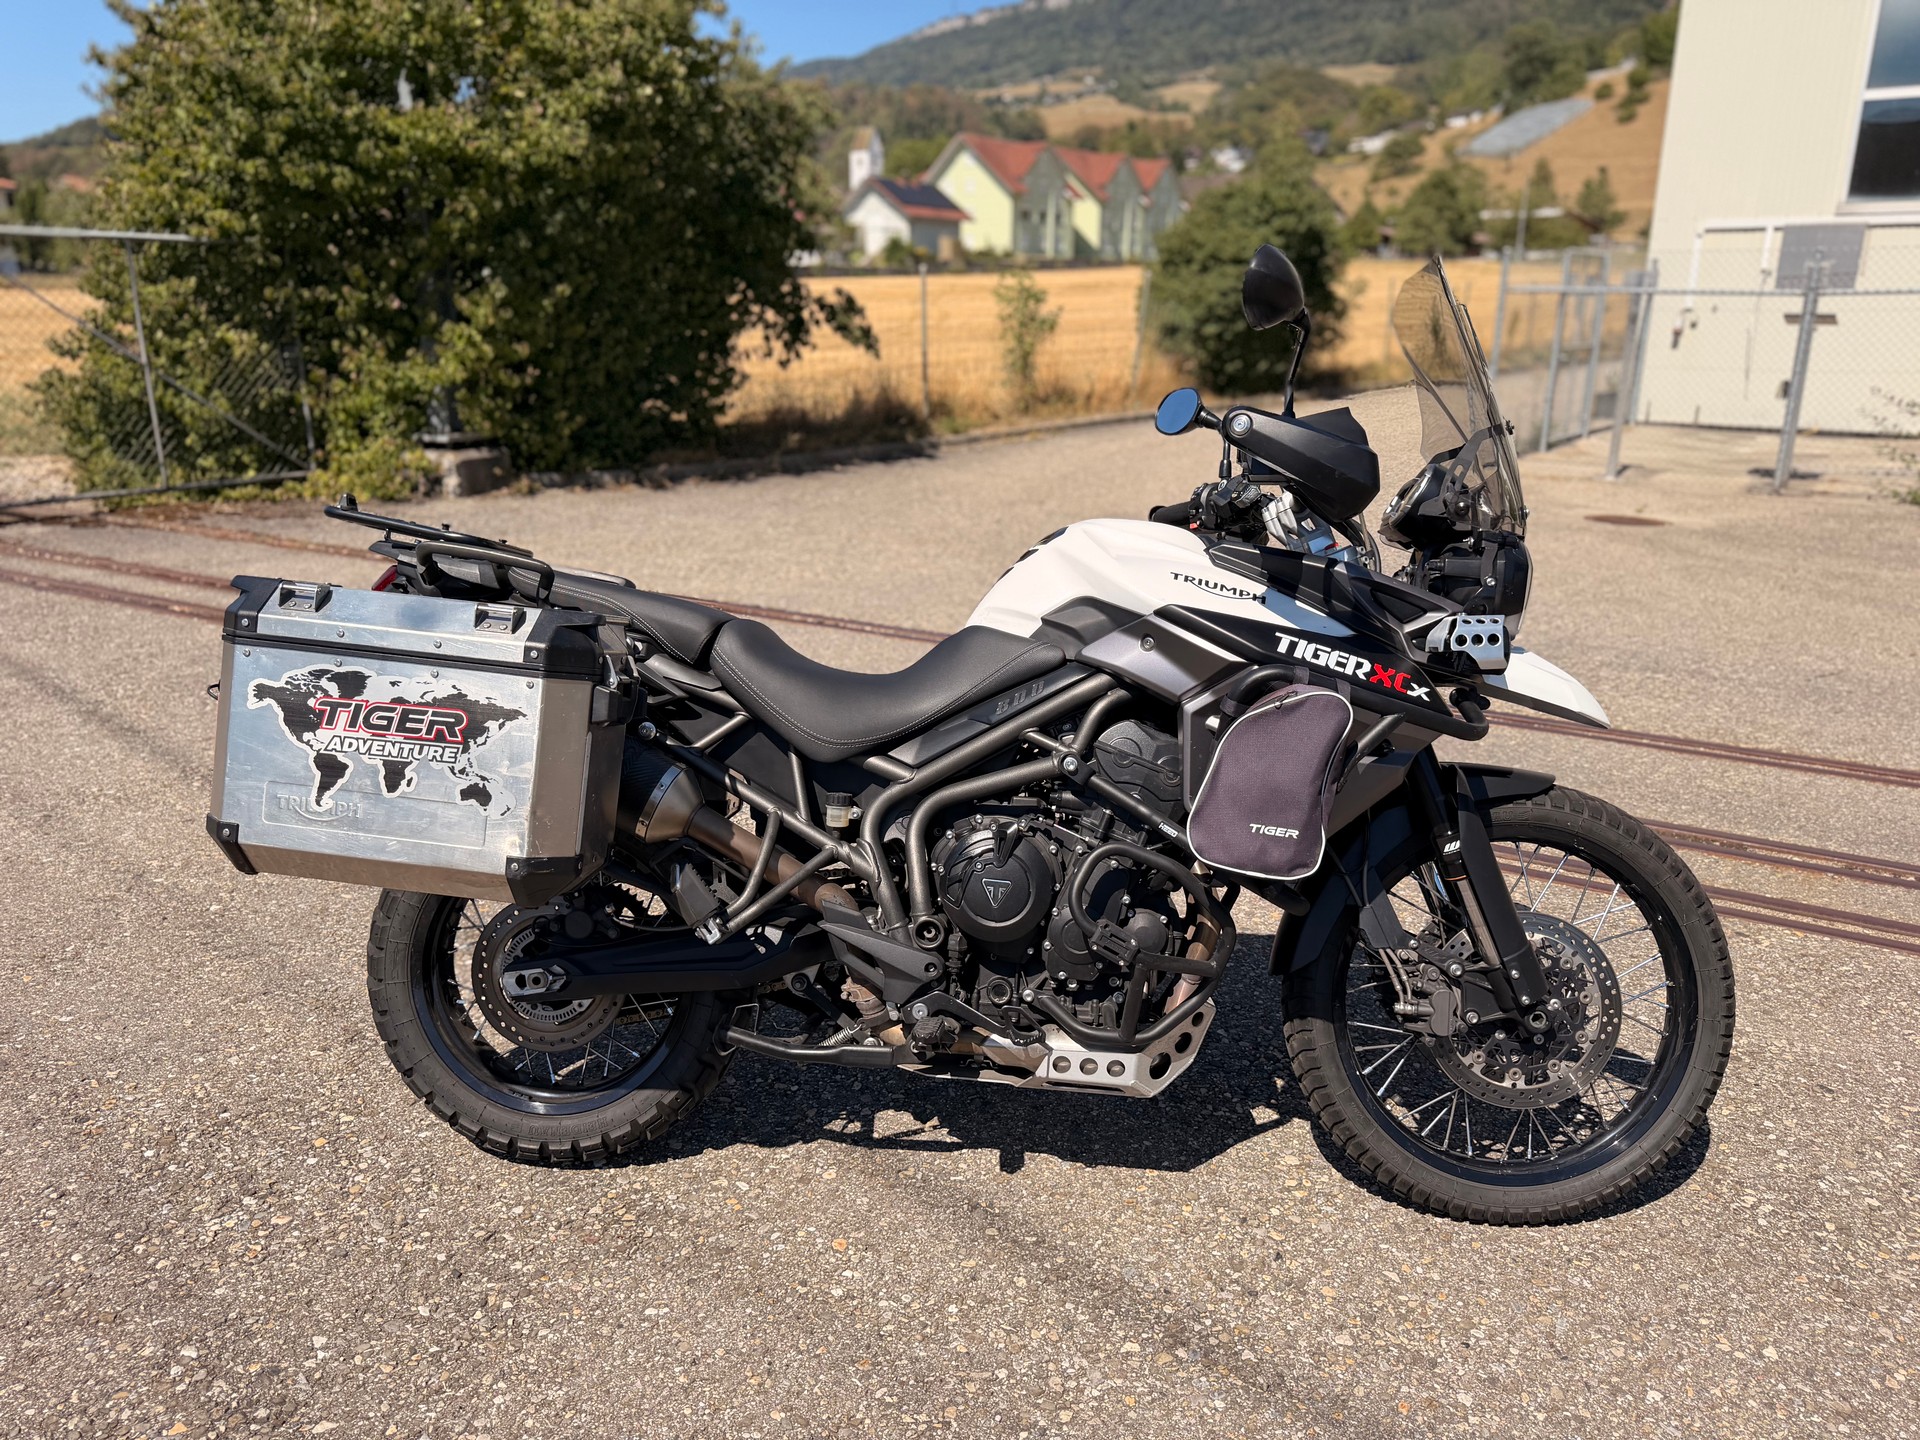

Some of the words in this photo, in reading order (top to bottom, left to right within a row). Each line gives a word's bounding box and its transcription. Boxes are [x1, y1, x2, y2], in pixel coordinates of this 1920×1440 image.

[1169, 571, 1267, 605] TRIUMPH
[315, 697, 467, 742] TIGER
[325, 735, 460, 763] ADVENTURE
[276, 793, 363, 818] TRIPH
[1249, 823, 1300, 839] TIGER
